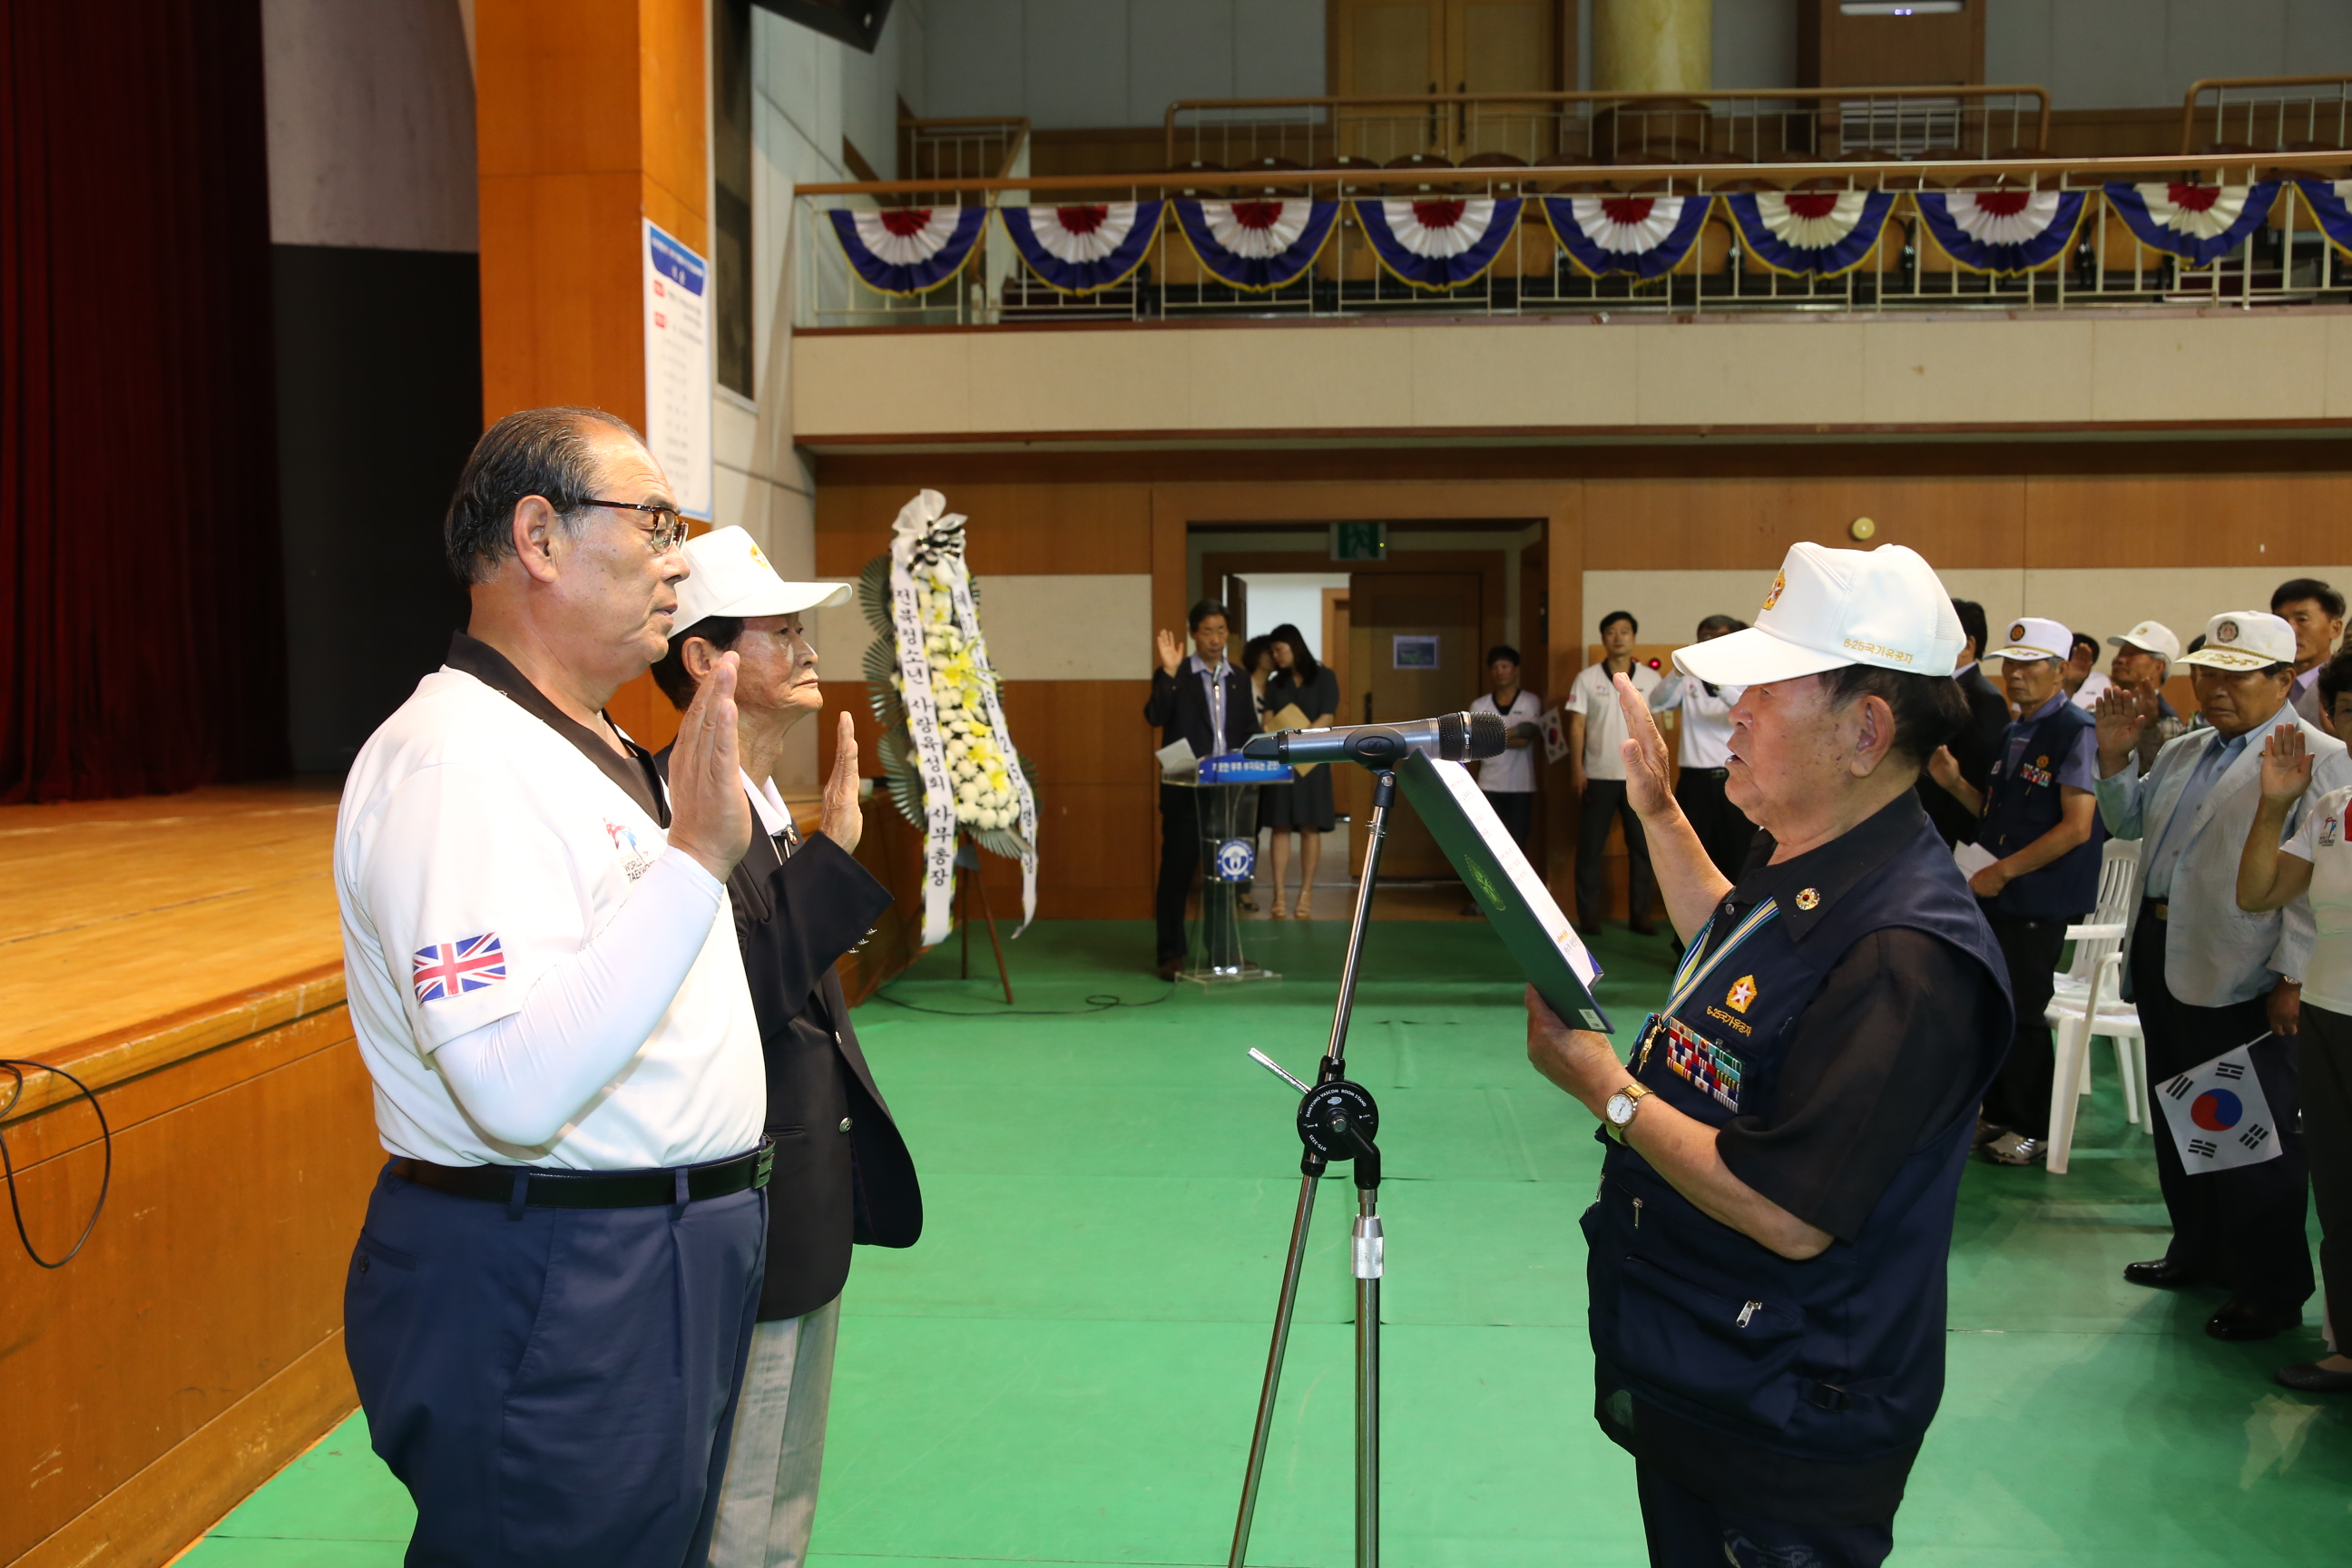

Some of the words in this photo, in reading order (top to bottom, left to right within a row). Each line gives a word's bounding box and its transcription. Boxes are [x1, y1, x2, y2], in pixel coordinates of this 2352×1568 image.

[928, 803, 955, 887] 사무총장
[1306, 1095, 1321, 1118] DAIKYUNG
[1320, 1089, 1339, 1097] VASCOM
[1340, 1089, 1355, 1097] BOOM
[1354, 1094, 1367, 1107] STAND
